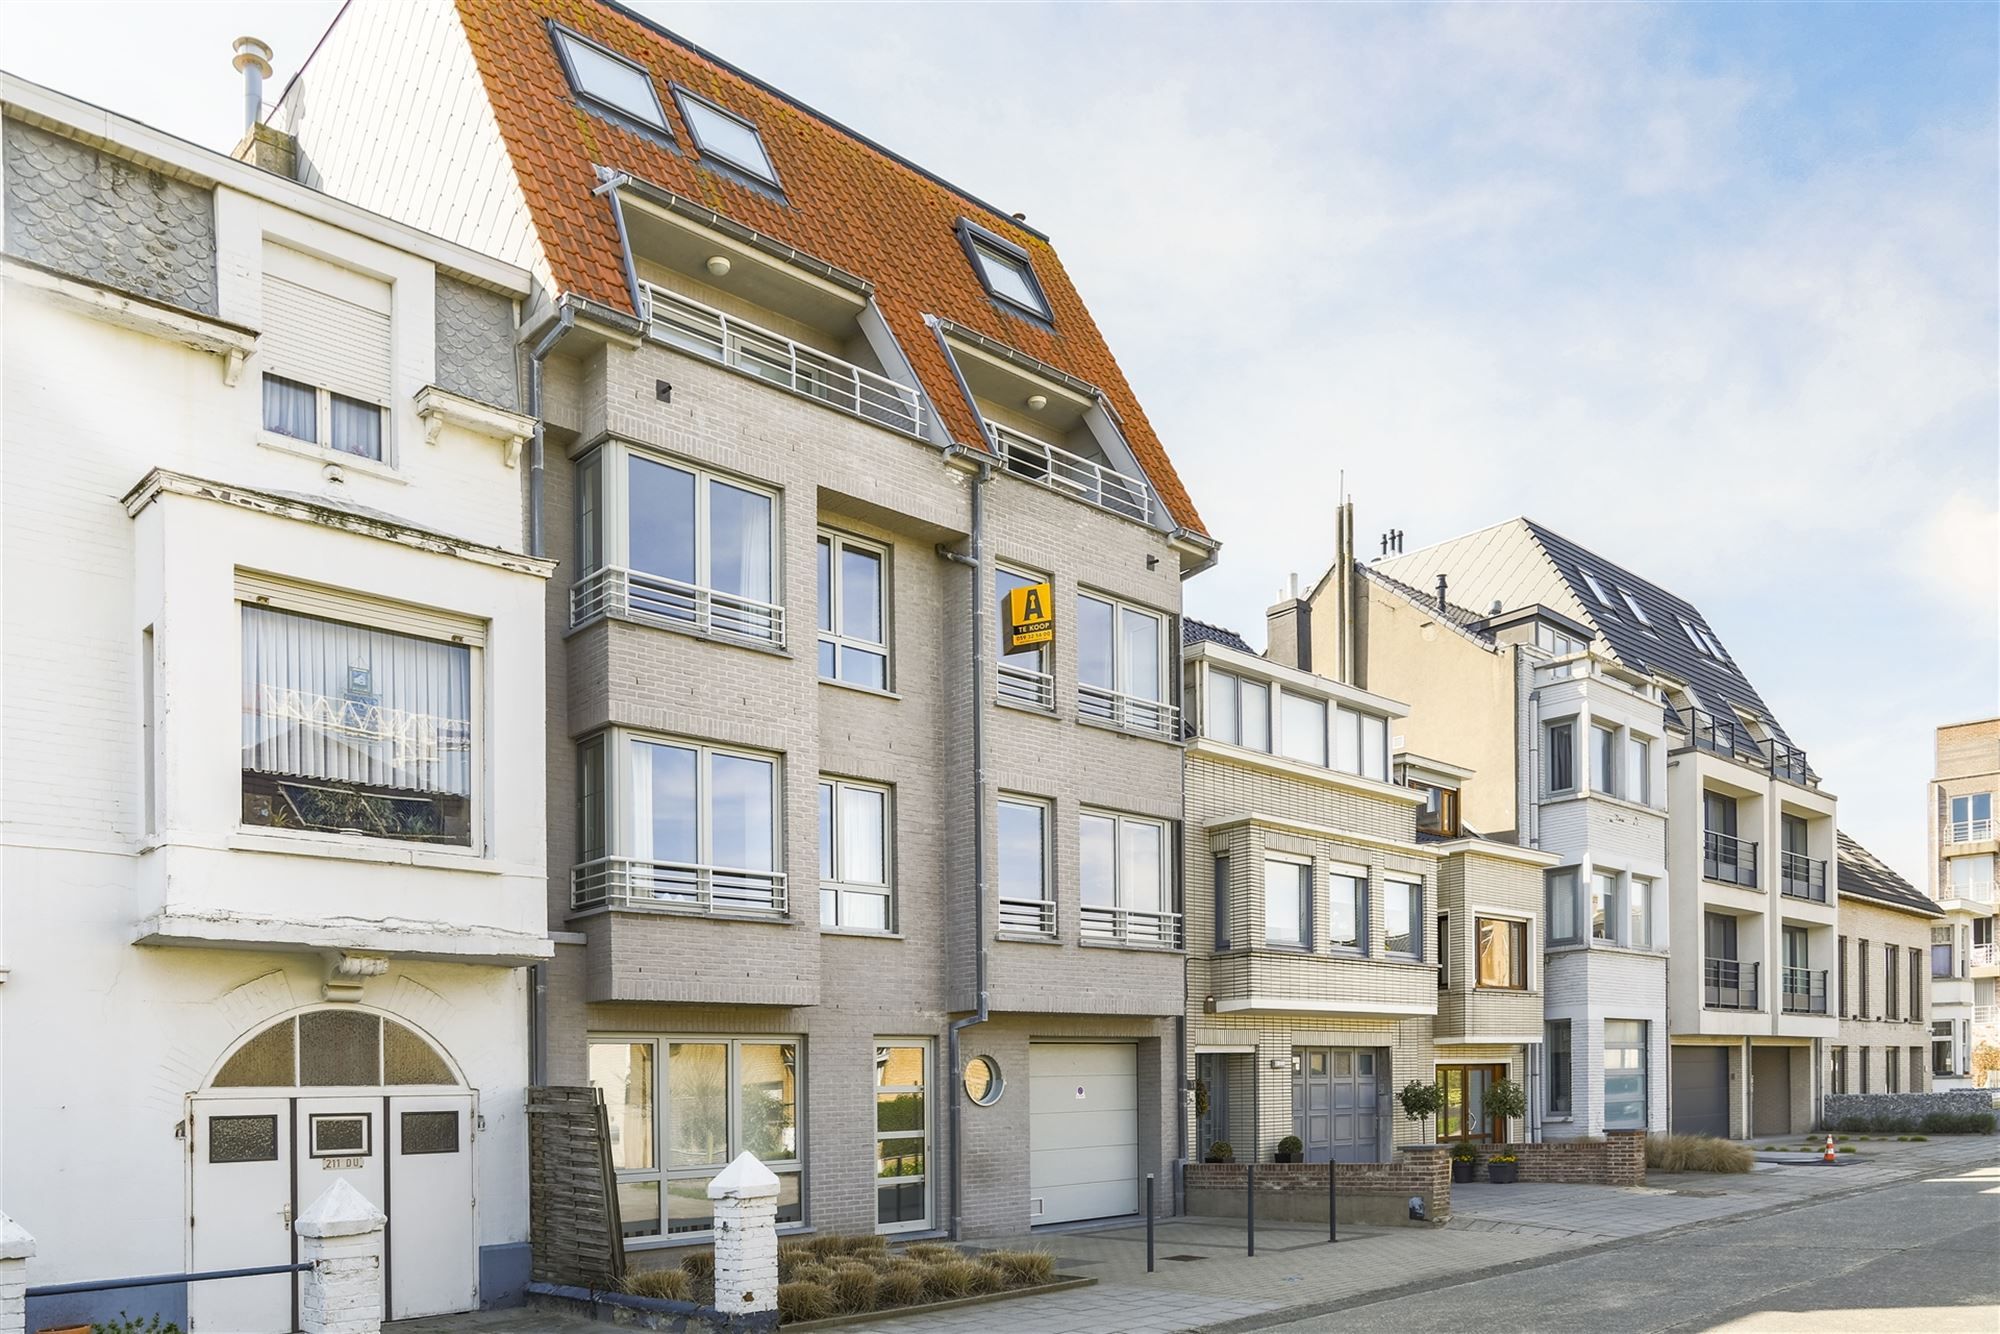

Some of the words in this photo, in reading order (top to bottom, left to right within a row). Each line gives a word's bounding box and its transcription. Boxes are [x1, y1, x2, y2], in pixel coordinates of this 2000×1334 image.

[1024, 589, 1044, 621] A
[1030, 623, 1050, 631] KOOP
[326, 1159, 340, 1168] 211
[346, 1158, 359, 1167] DU
